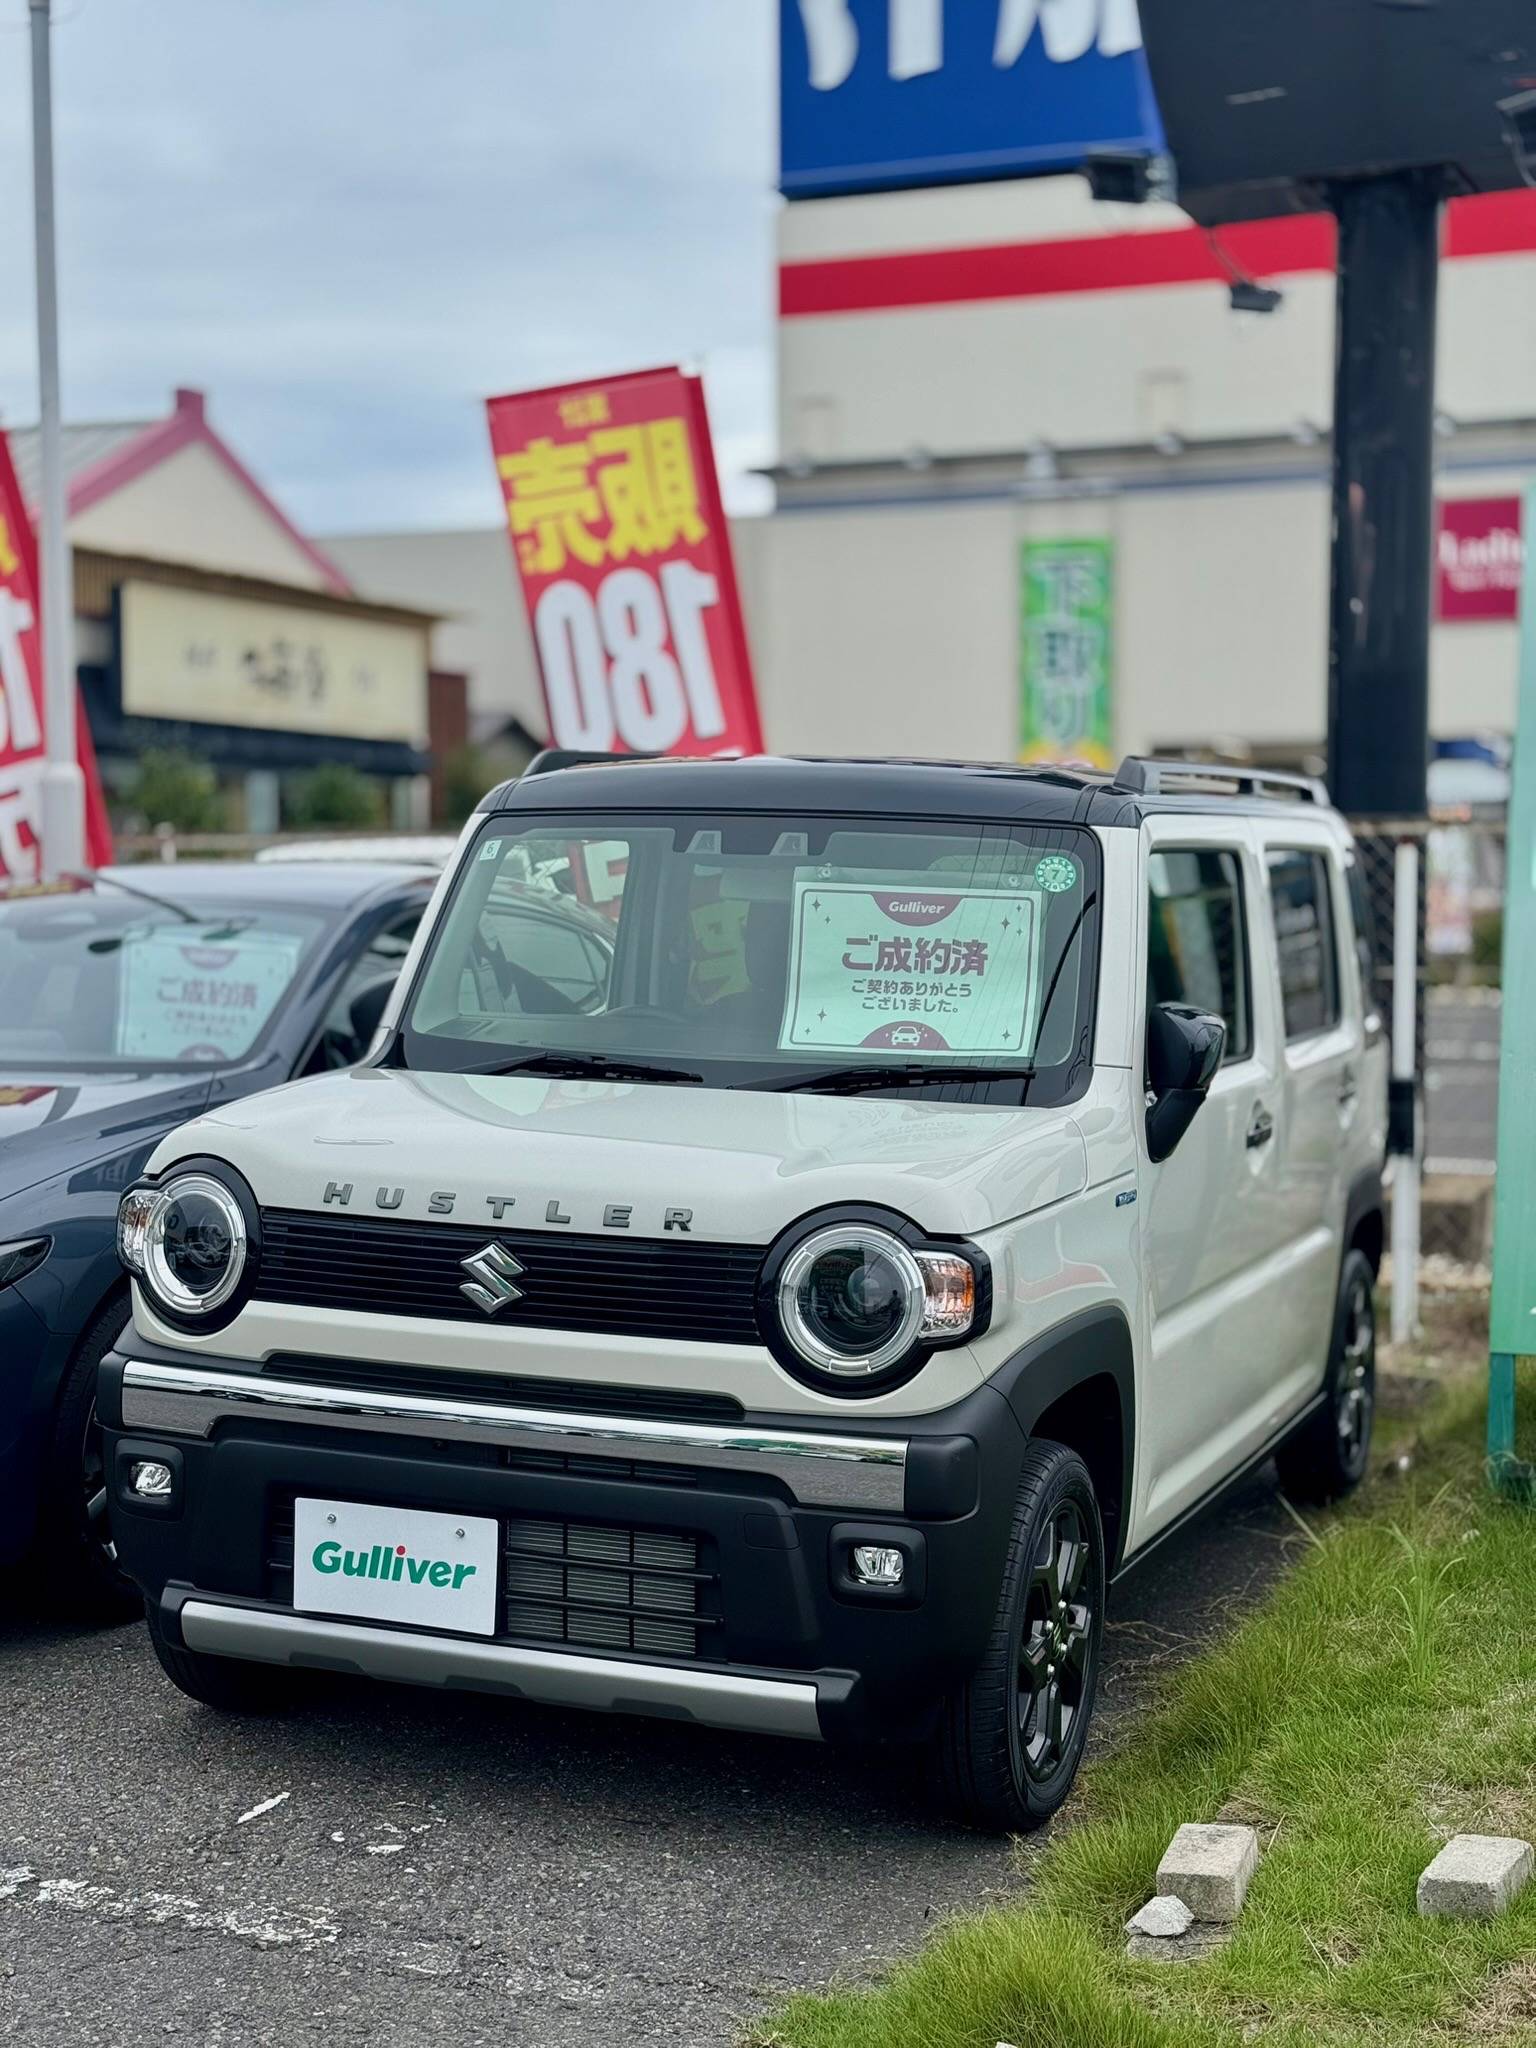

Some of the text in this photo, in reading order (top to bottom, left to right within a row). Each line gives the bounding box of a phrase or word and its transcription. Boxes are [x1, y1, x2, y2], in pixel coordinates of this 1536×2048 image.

[1051, 869, 1060, 880] 7
[889, 901, 945, 915] Gulliver
[842, 934, 989, 977] ご成約済
[851, 978, 972, 998] ご契約ありがとう
[861, 995, 960, 1014] ございました。
[323, 1182, 692, 1232] HUSTLER
[312, 1541, 477, 1590] Gulliver
